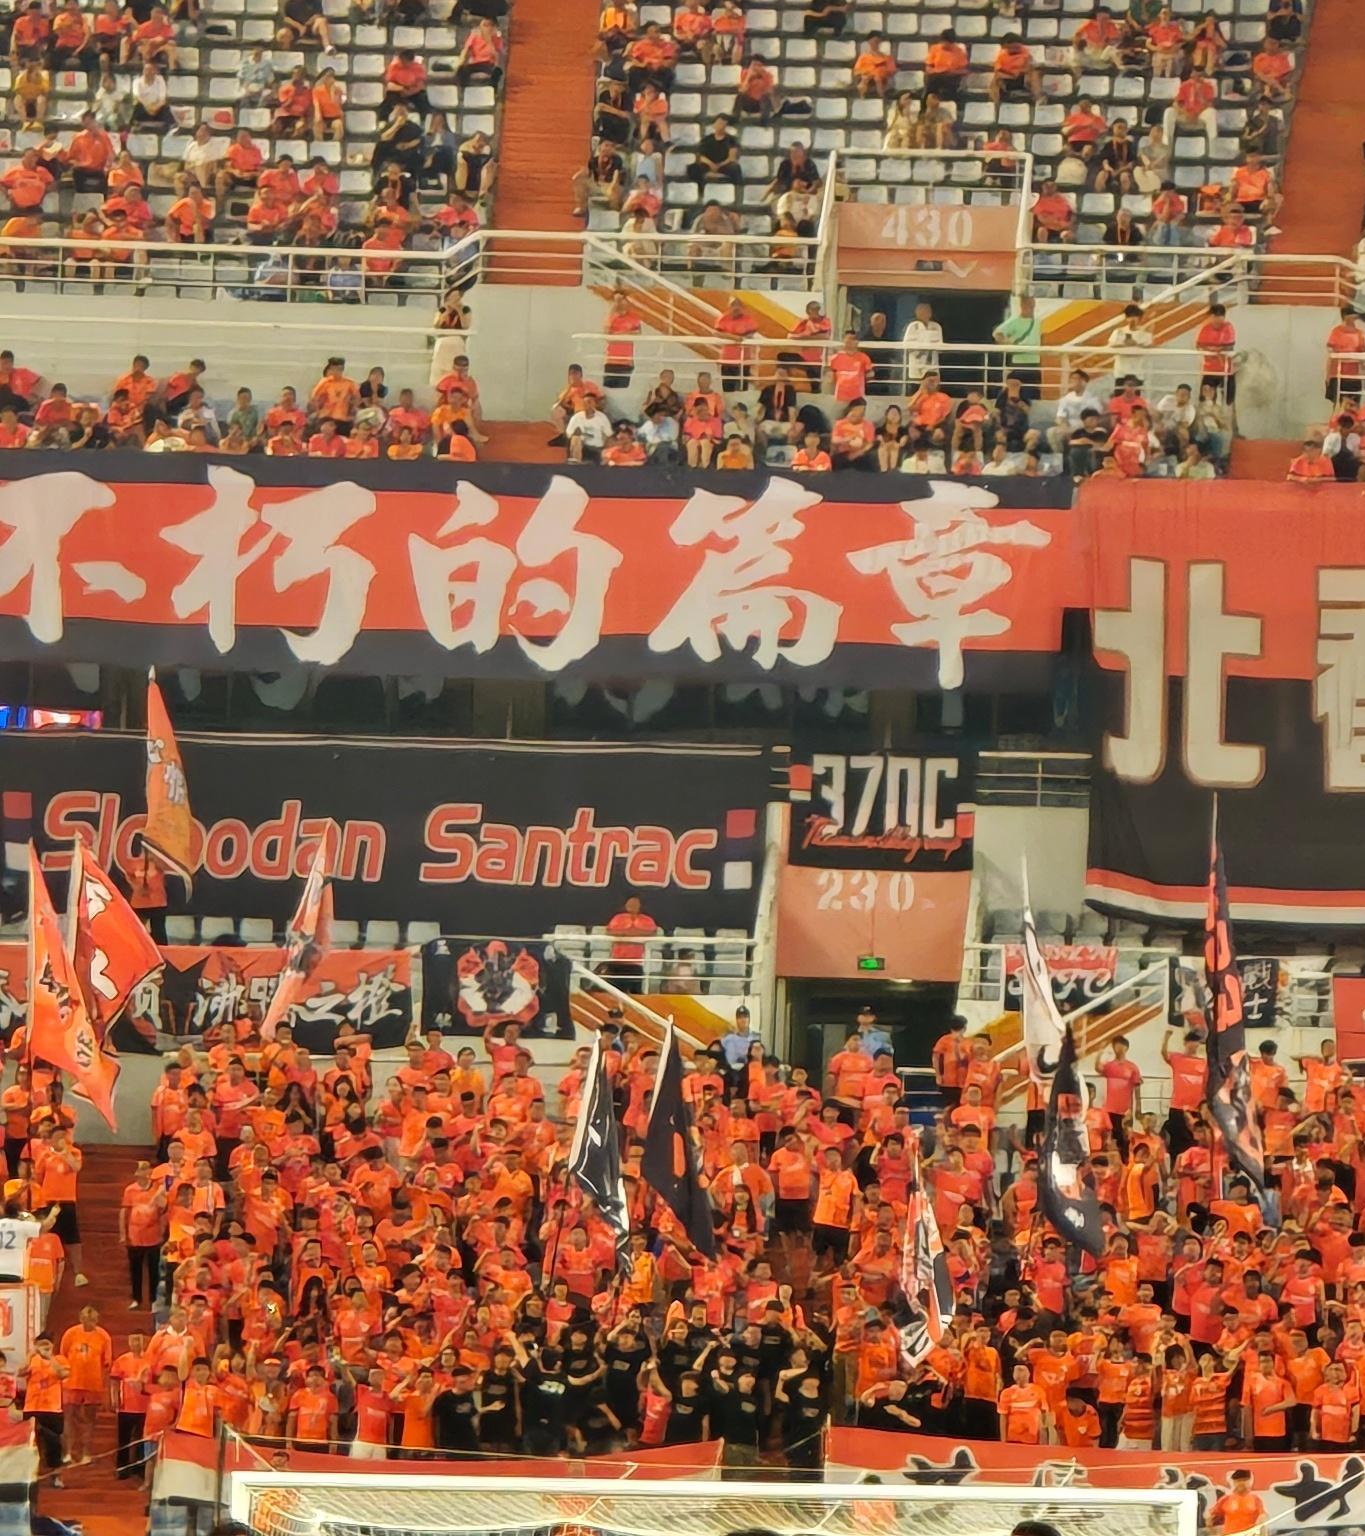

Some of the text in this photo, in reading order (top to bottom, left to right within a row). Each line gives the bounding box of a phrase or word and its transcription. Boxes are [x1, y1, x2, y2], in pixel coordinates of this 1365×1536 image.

[880, 207, 974, 247] 430
[0, 465, 1051, 690] 不朽的篇章
[41, 791, 387, 884] Sloodan
[419, 802, 719, 889] Santrac
[816, 870, 915, 912] 230
